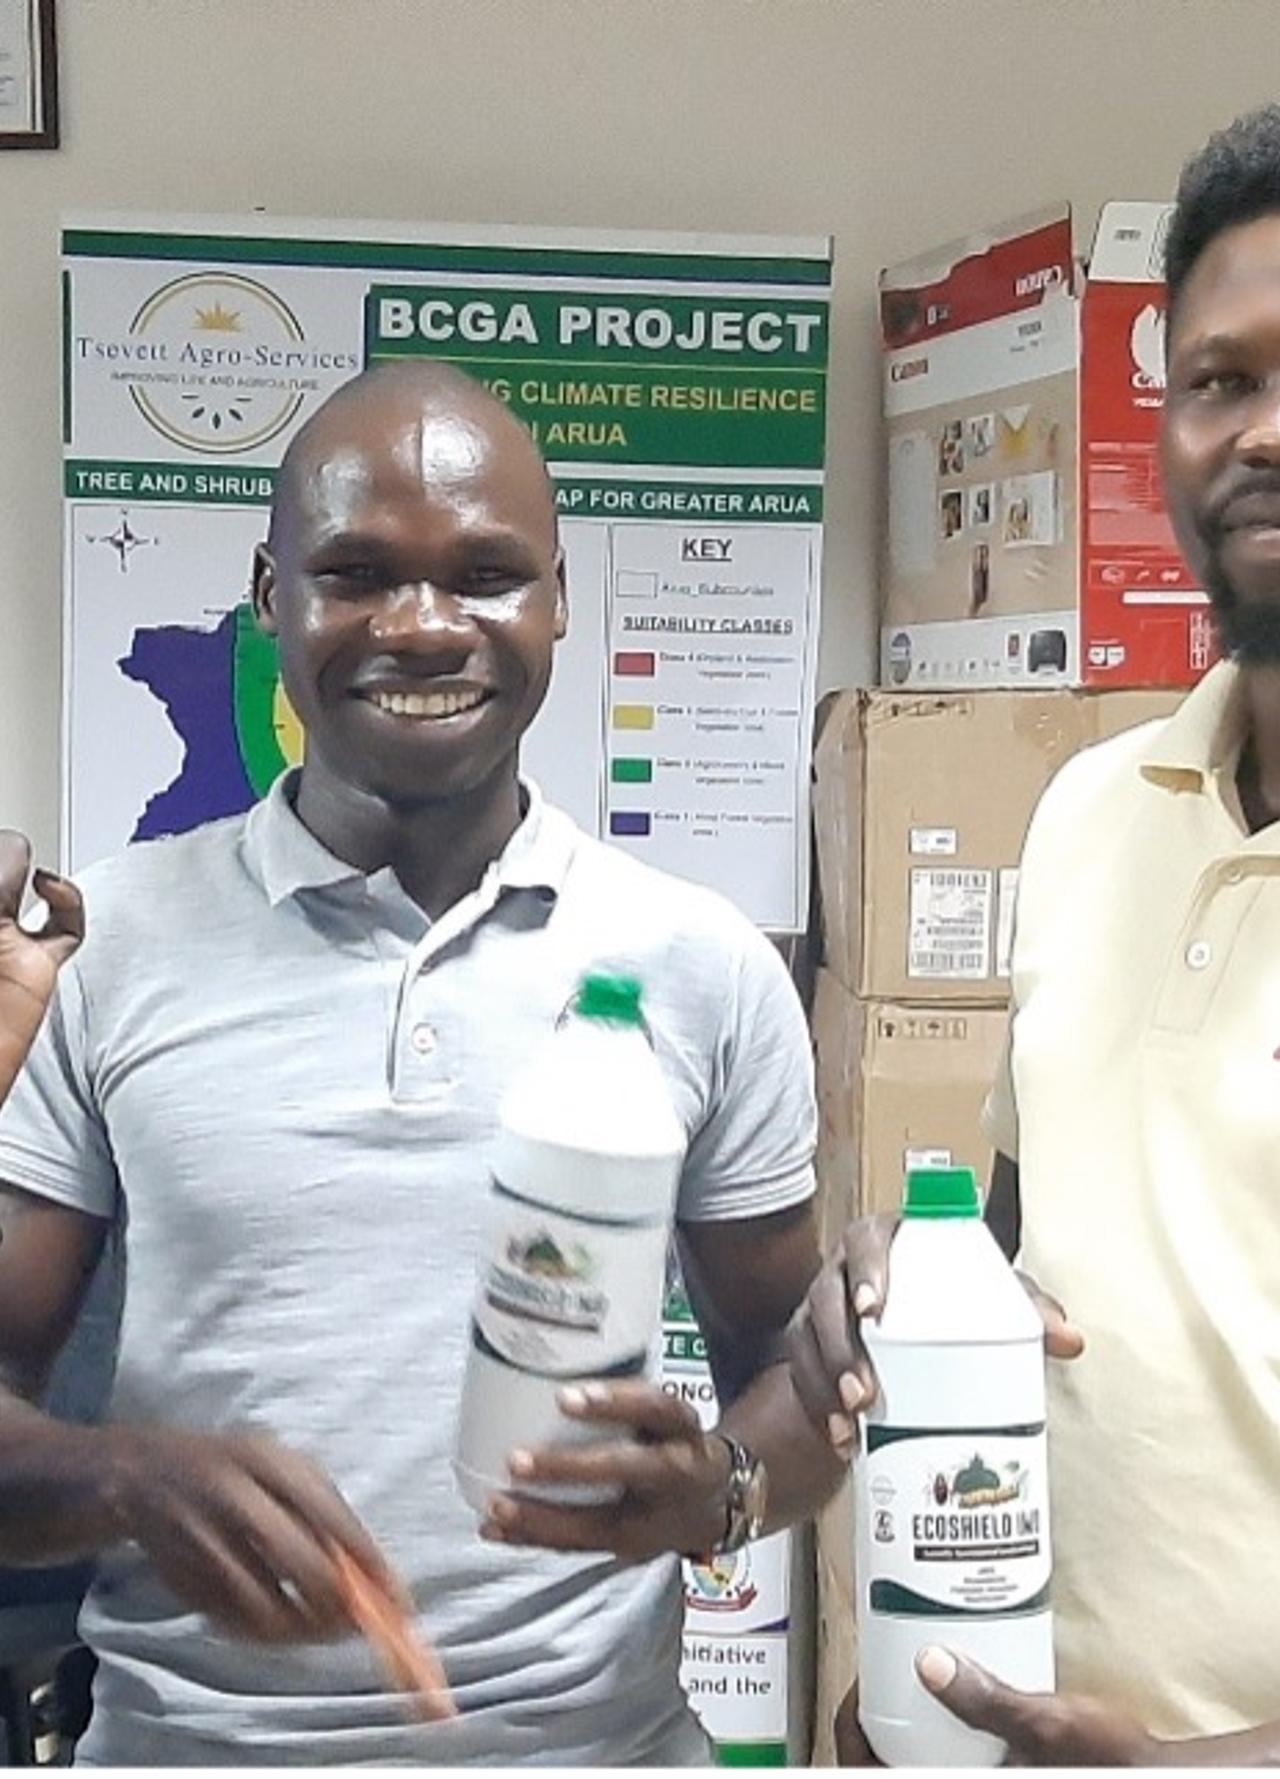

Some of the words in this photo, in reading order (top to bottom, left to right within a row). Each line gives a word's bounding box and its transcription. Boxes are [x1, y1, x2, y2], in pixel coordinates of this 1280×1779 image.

[379, 299, 538, 344] BCGA
[559, 306, 820, 352] PROJECT
[179, 341, 360, 370] Agro-Services
[520, 380, 641, 408] CLIMATE
[651, 386, 817, 413] RESILIENCE
[546, 422, 627, 447] ARUA
[77, 472, 133, 490] TREE
[139, 473, 188, 493] AND
[195, 475, 273, 496] SHRUB
[590, 490, 634, 509] FOR
[641, 493, 743, 512] GREATER
[749, 495, 811, 514] ARUA
[682, 538, 733, 562] KEY
[623, 616, 714, 632] SUITABILITY
[720, 618, 793, 635] CLASSES
[913, 1514, 1012, 1541] ECOSHIELD
[688, 1677, 727, 1695] and
[736, 1678, 771, 1696] the
